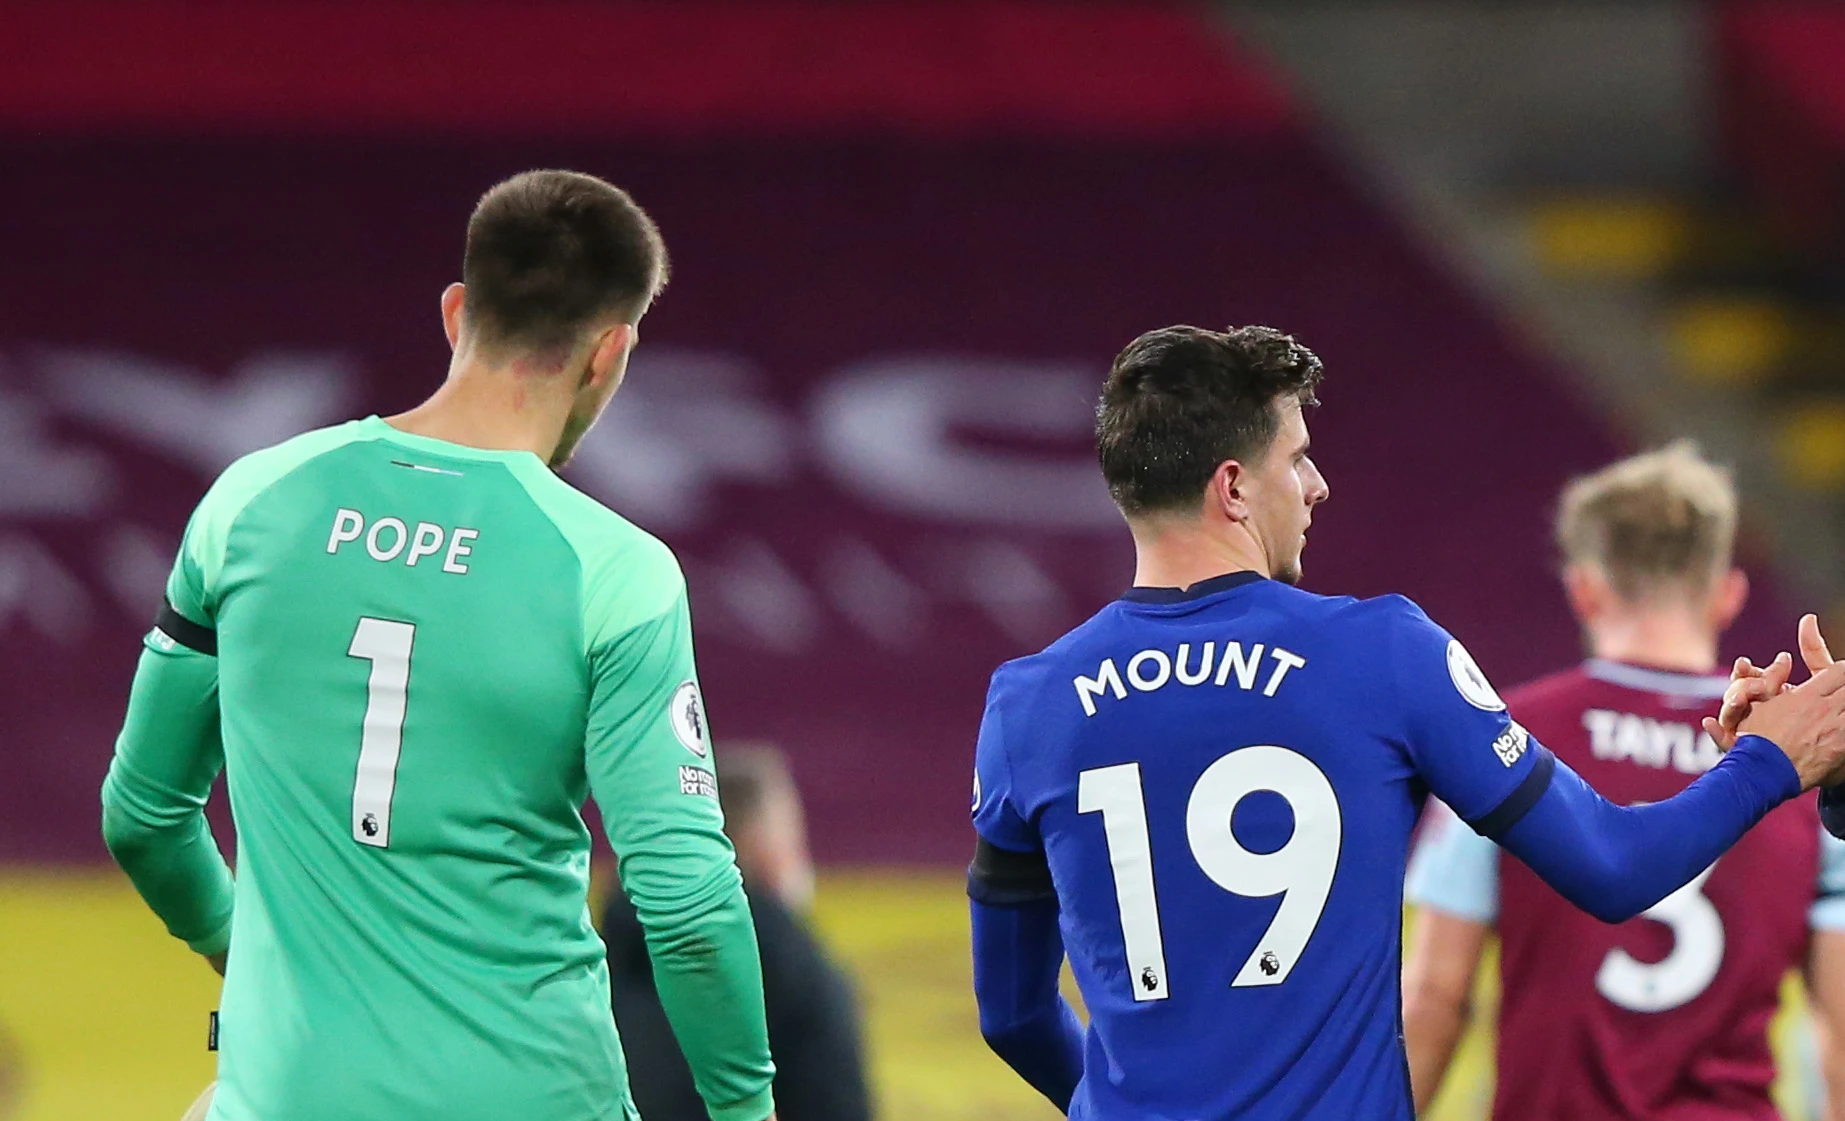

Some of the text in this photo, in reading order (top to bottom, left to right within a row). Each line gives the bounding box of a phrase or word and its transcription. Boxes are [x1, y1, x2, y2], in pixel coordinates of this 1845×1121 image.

[325, 507, 480, 575] POPE
[346, 615, 417, 849] 1
[1072, 640, 1307, 718] MOUNT
[1076, 744, 1343, 1002] 19
[1596, 856, 1726, 1014] 3
